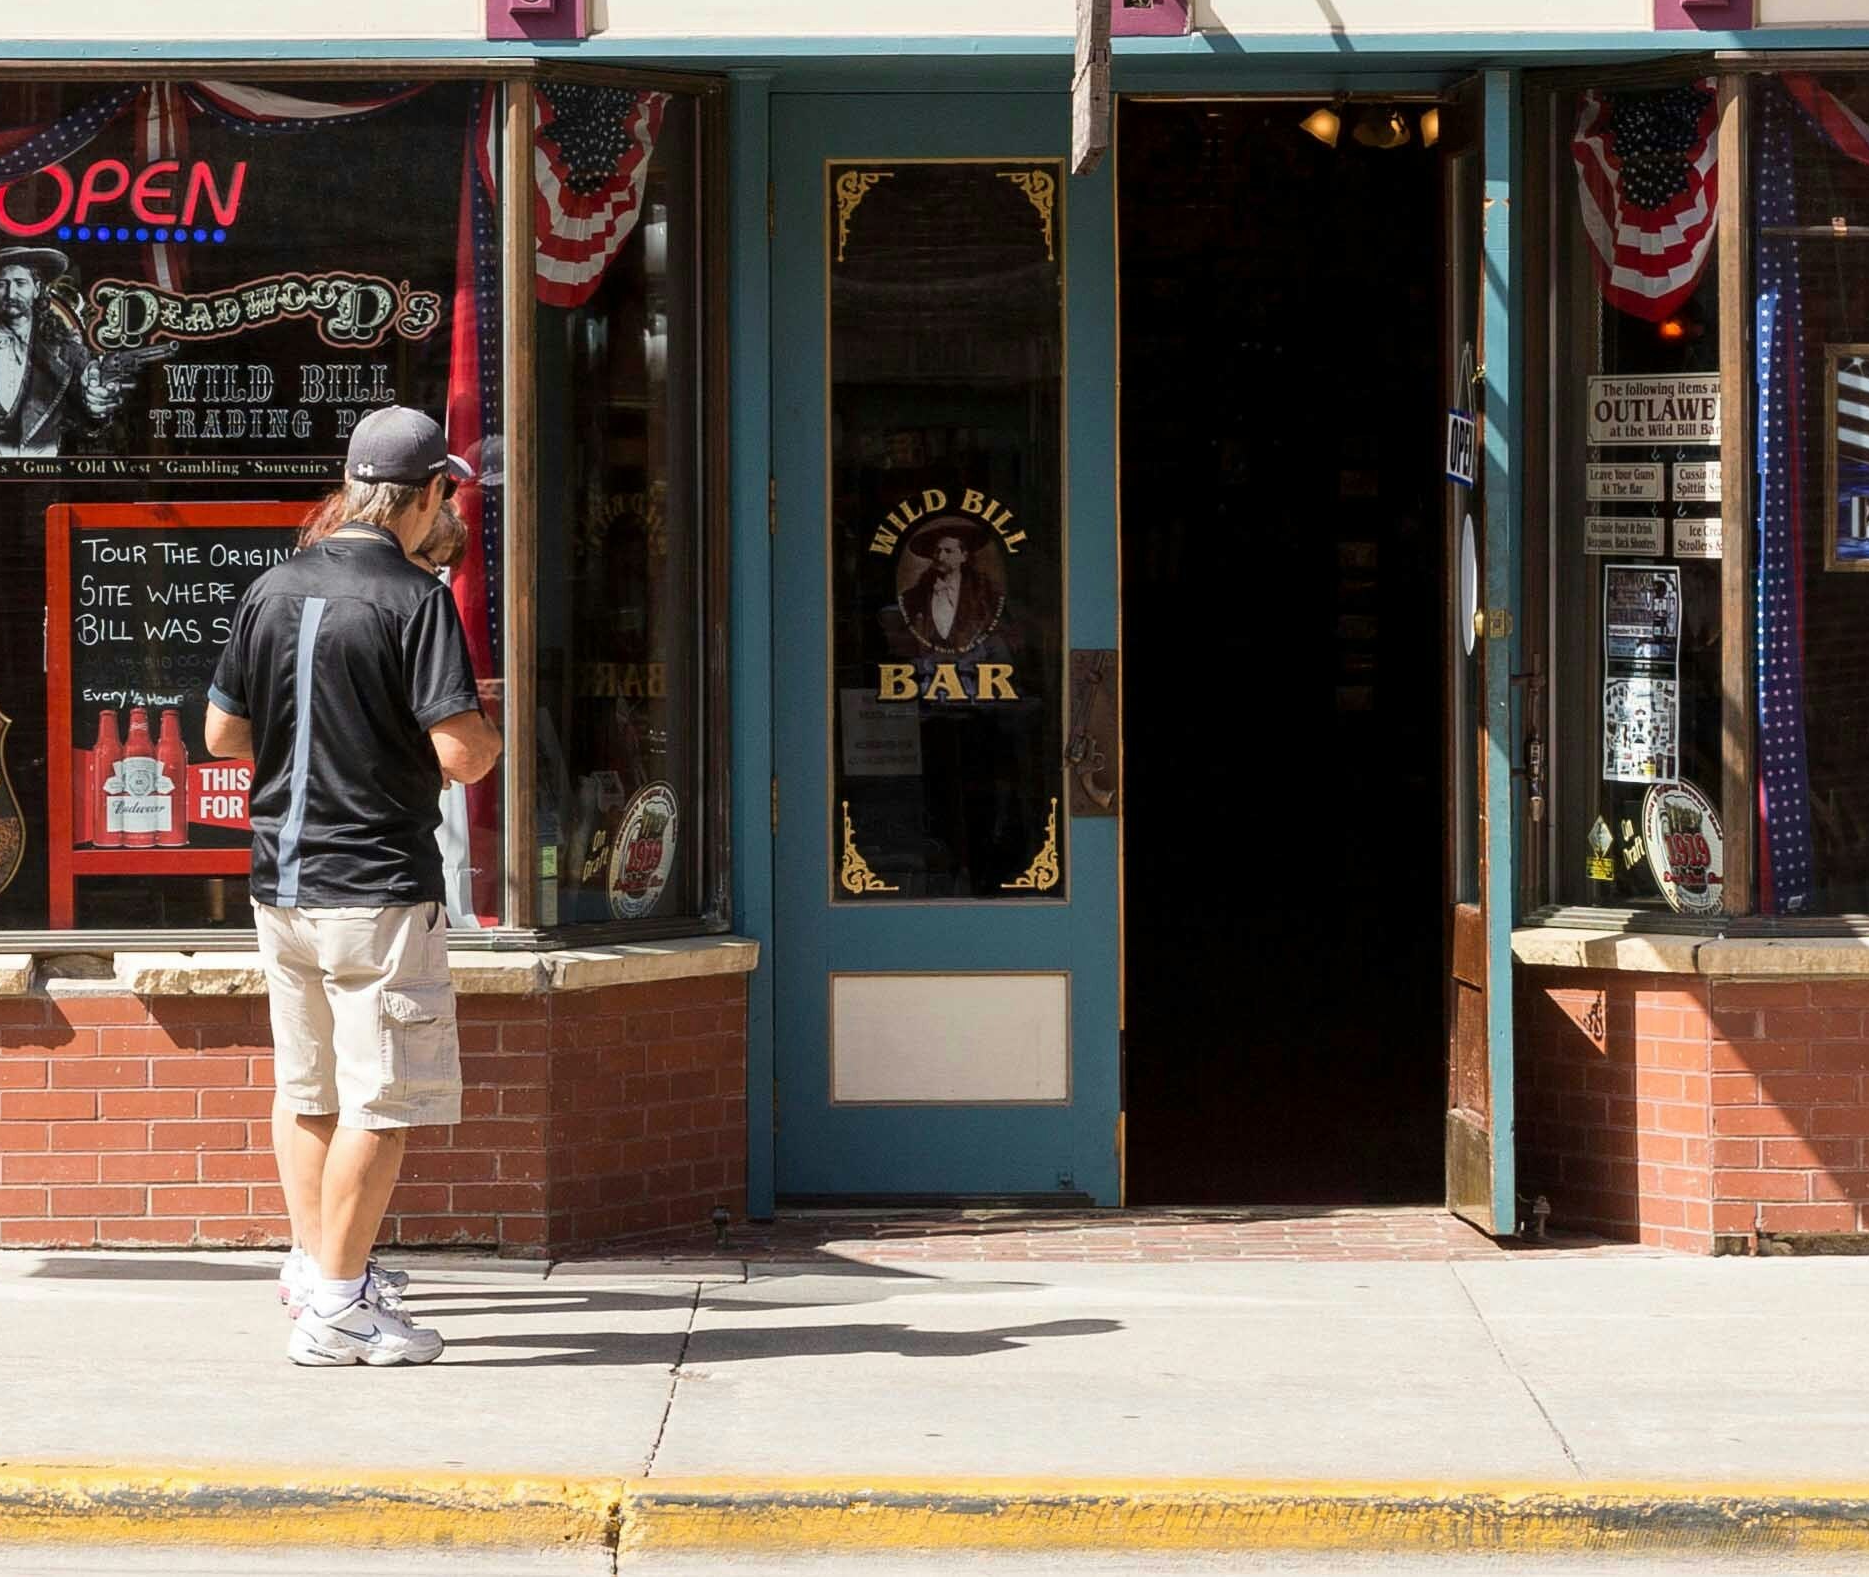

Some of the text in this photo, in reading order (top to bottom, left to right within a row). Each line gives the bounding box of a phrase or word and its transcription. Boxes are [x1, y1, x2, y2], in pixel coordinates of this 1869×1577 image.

[163, 364, 396, 403] WILD BILL
[1603, 382, 1708, 398] The following items
[1594, 398, 1717, 423] OUTLAWE
[148, 408, 312, 439] TRADING
[1610, 424, 1622, 437] at
[1625, 424, 1645, 437] the
[1648, 424, 1673, 437] Wild
[1677, 423, 1697, 436] Bill
[112, 460, 151, 473] West
[1590, 468, 1655, 481] Leave Your Guns
[1601, 485, 1643, 494] At The Bar
[869, 488, 1029, 557] WILD BILL
[1690, 525, 1702, 536] Ice
[146, 582, 236, 605] WHERE
[144, 619, 202, 644] WAS
[877, 662, 1019, 702] BAR
[83, 688, 127, 709] Every
[199, 768, 251, 791] THIS
[200, 796, 244, 819] FOR
[626, 837, 663, 872] 1919
[1665, 832, 1711, 867] 1919
